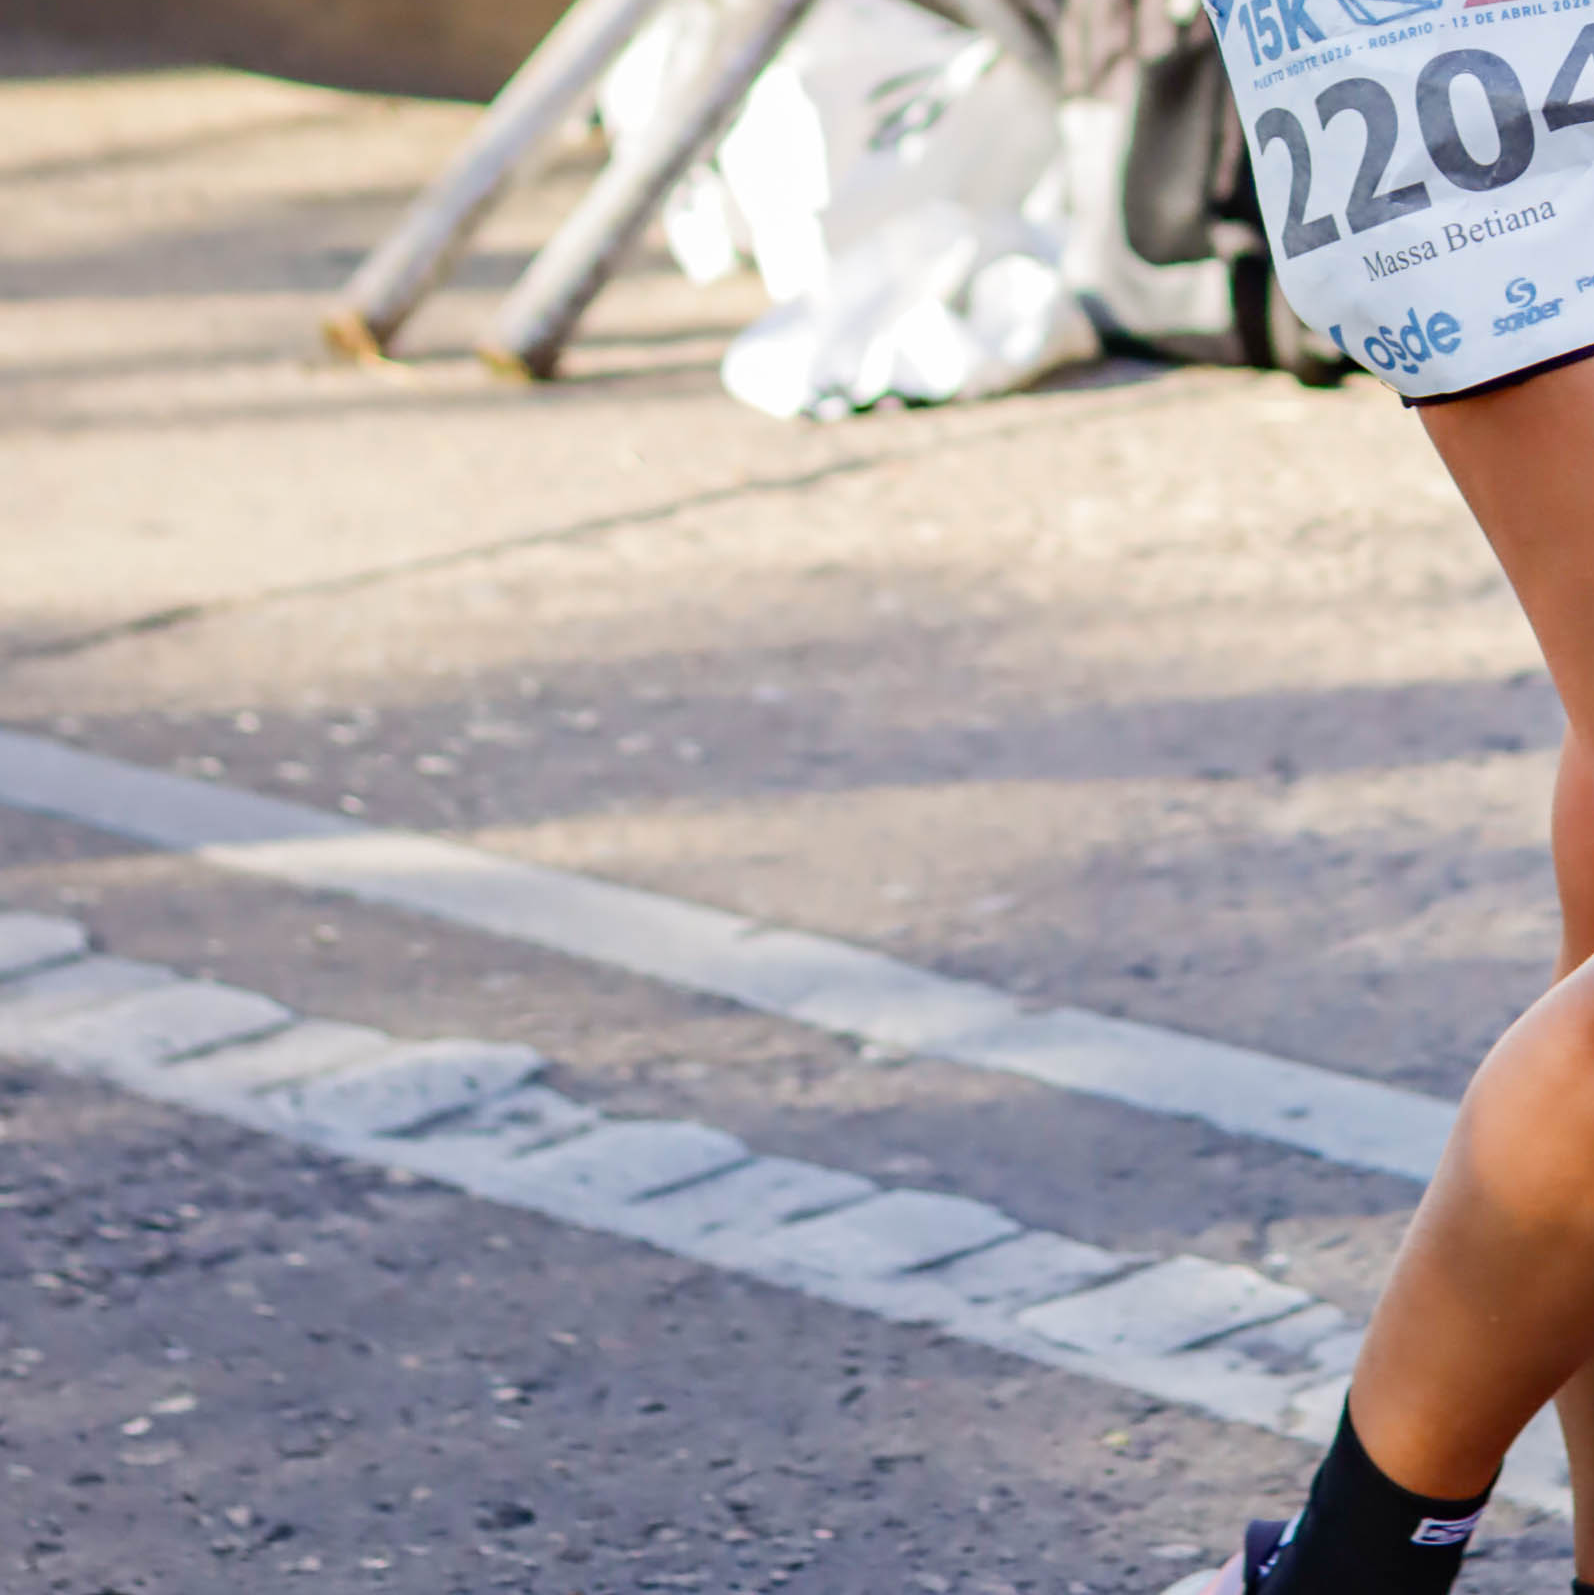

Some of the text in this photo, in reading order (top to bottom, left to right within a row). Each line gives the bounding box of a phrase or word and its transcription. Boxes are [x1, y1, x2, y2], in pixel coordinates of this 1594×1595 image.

[1368, 22, 1433, 49] ROSARIO
[1452, 17, 1469, 29] 12
[1475, 12, 1495, 26] DE
[1501, 5, 1546, 22] ABRIL
[1362, 201, 1557, 282] Massa Betiana
[1363, 306, 1462, 375] osde
